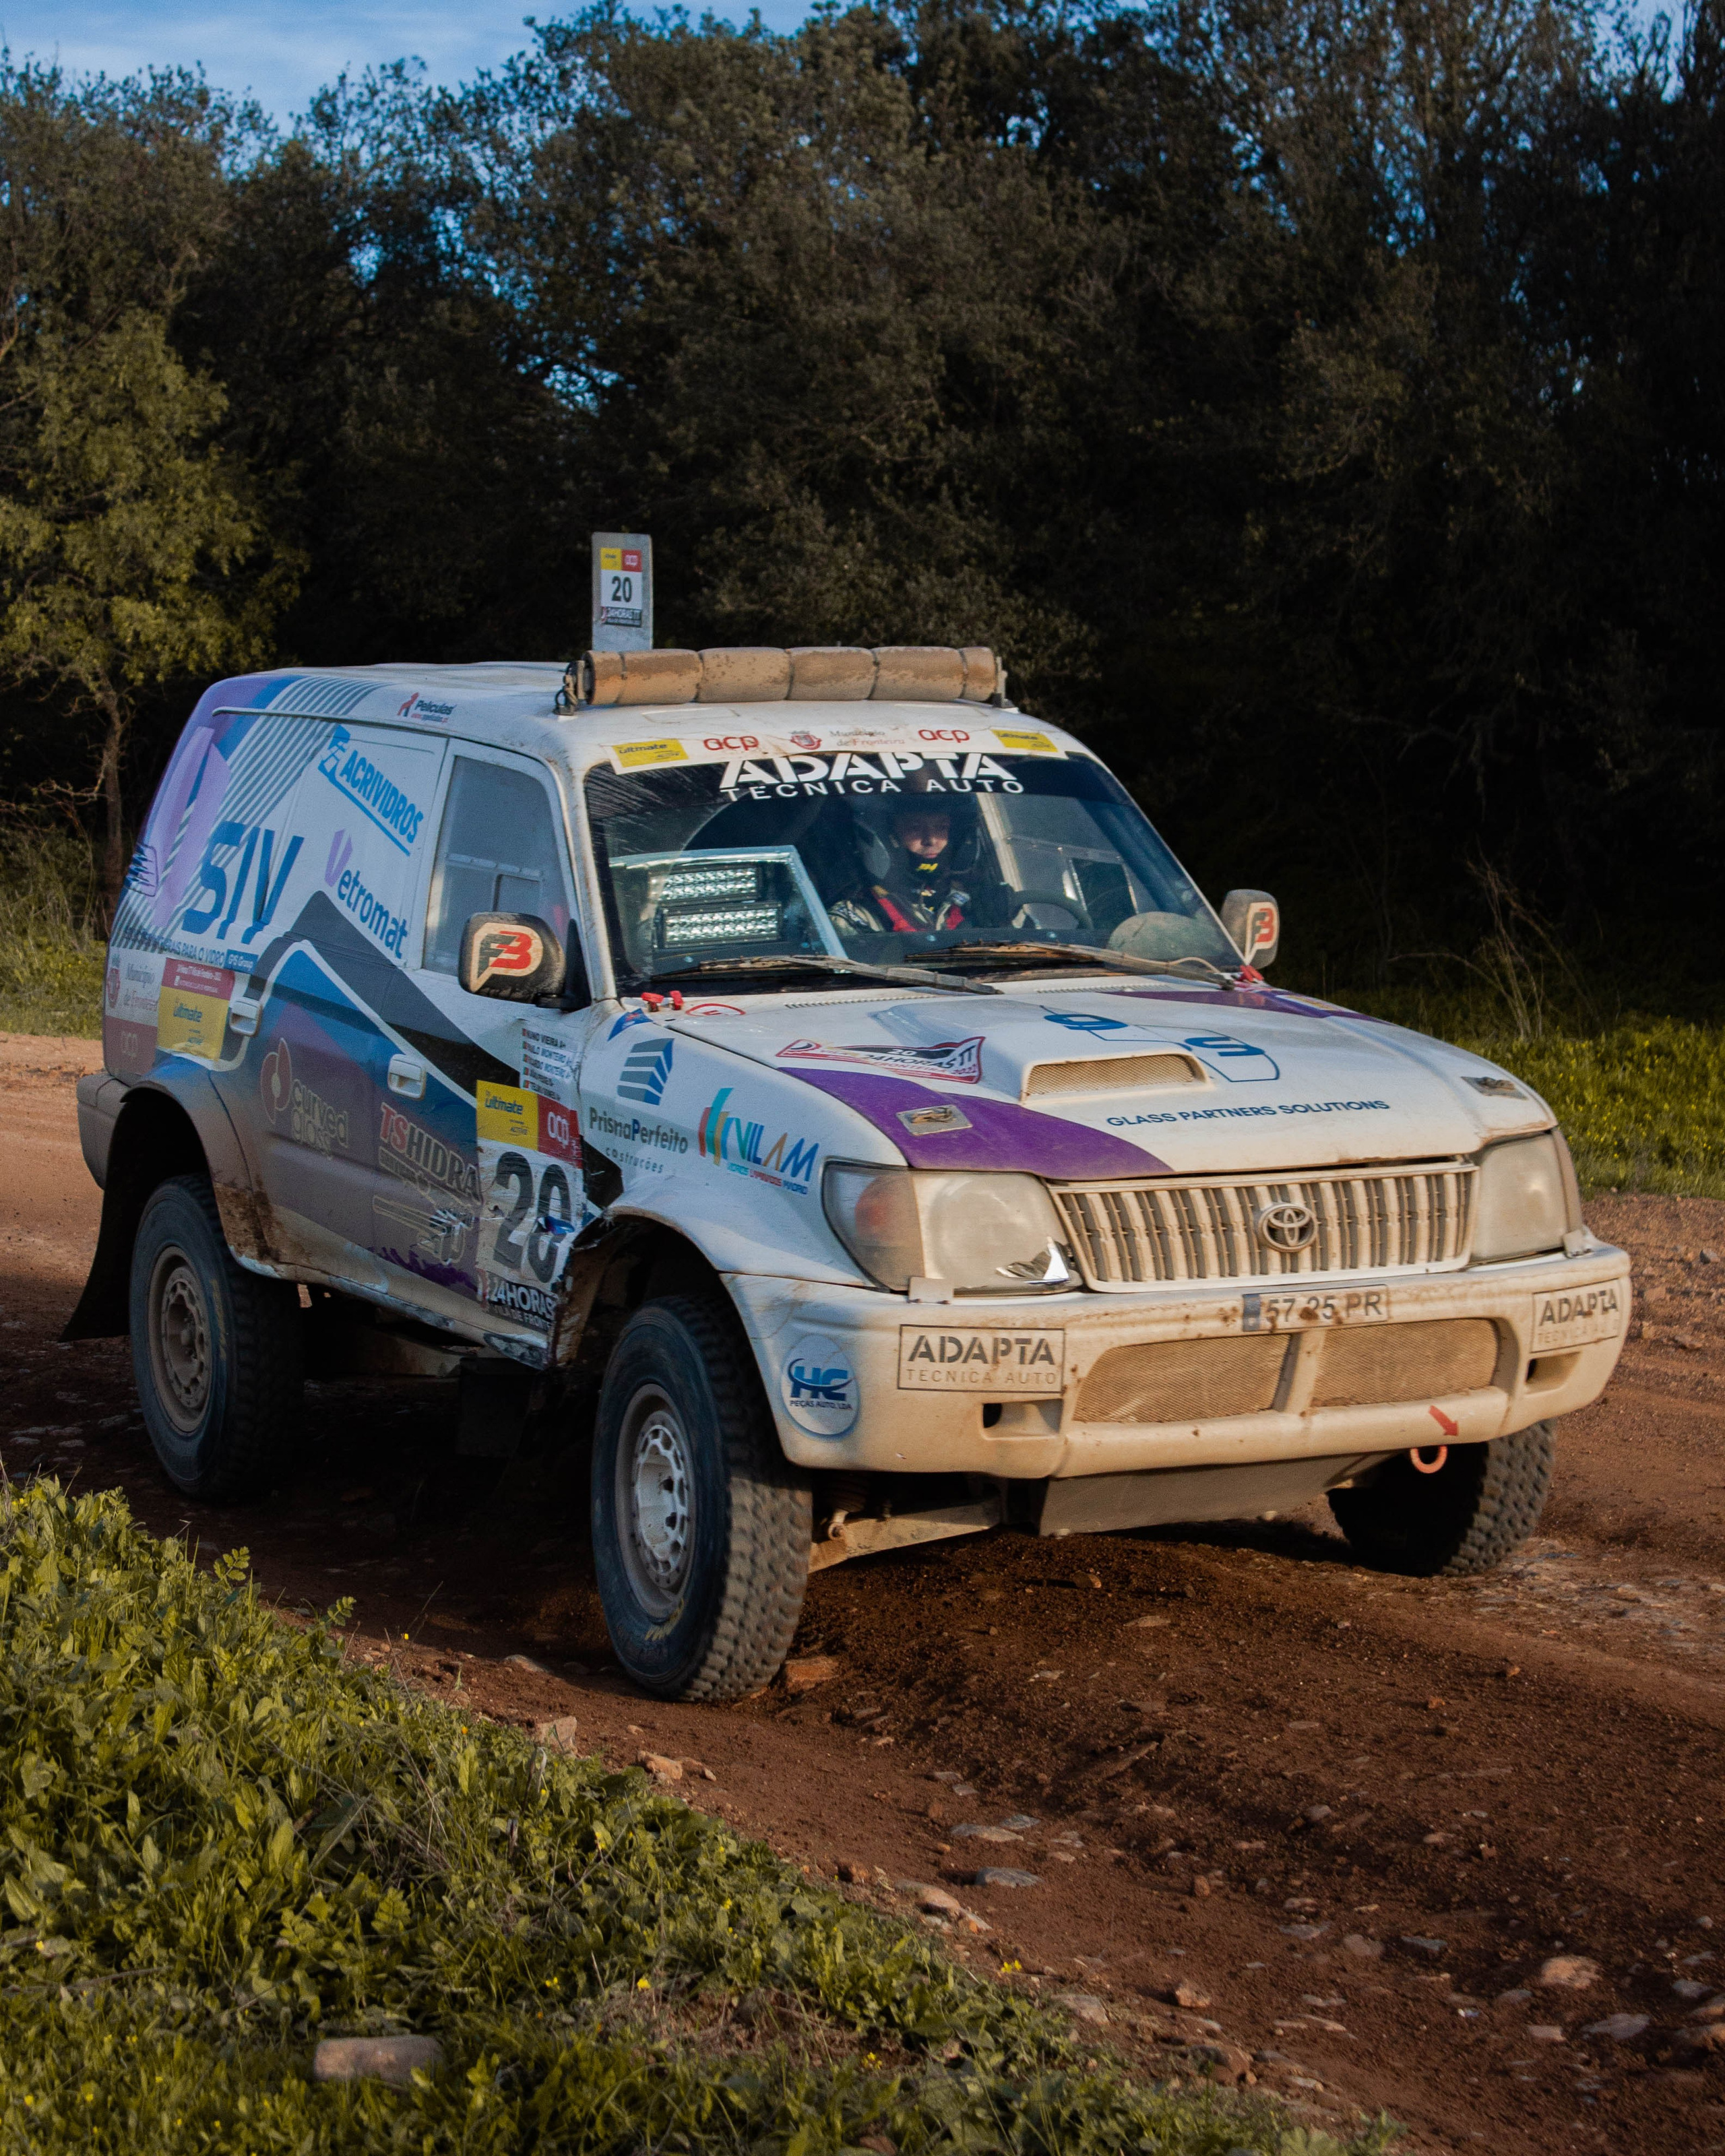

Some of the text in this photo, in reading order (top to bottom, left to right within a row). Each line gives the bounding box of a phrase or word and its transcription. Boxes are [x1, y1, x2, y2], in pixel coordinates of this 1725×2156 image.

[611, 575, 632, 602] 20
[703, 735, 759, 751] acp
[918, 730, 970, 742] acp
[720, 751, 1017, 789] ADAPTA
[340, 750, 423, 843] ACRIVIDROS
[720, 779, 1024, 802] TECNICA AUTO
[183, 821, 305, 945] SIV
[863, 1054, 956, 1069] 24HORAS
[484, 1096, 523, 1115] ultimate
[1106, 1100, 1391, 1127] GLASS PARTNERS SOLUTIONS
[493, 1151, 572, 1283] 20
[1347, 1292, 1383, 1317] PR
[1539, 1288, 1619, 1326] ADAPTA
[908, 1335, 1055, 1365] ADAPTA
[790, 1366, 848, 1401] HC
[906, 1369, 1056, 1385] TECNICA AUTO
